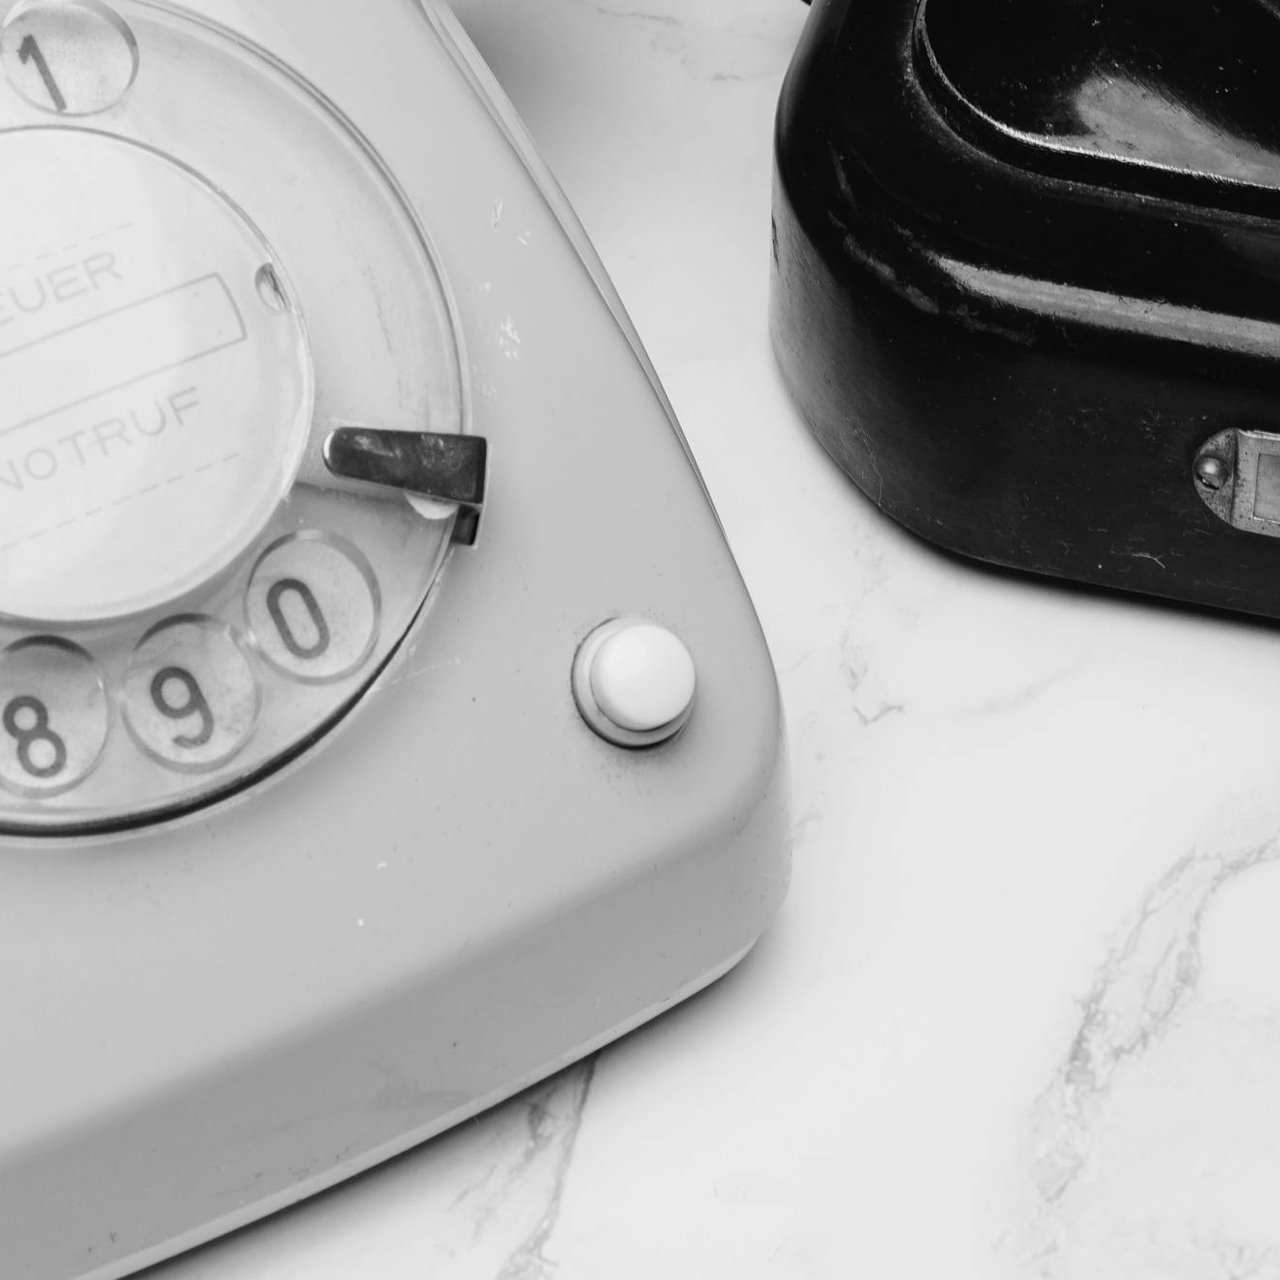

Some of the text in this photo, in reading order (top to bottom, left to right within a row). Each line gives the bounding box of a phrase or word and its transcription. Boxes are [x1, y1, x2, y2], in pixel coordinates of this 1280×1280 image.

[16, 34, 69, 113] 1
[266, 577, 331, 660] 0
[1, 695, 68, 777] 8
[149, 666, 214, 748] 9
